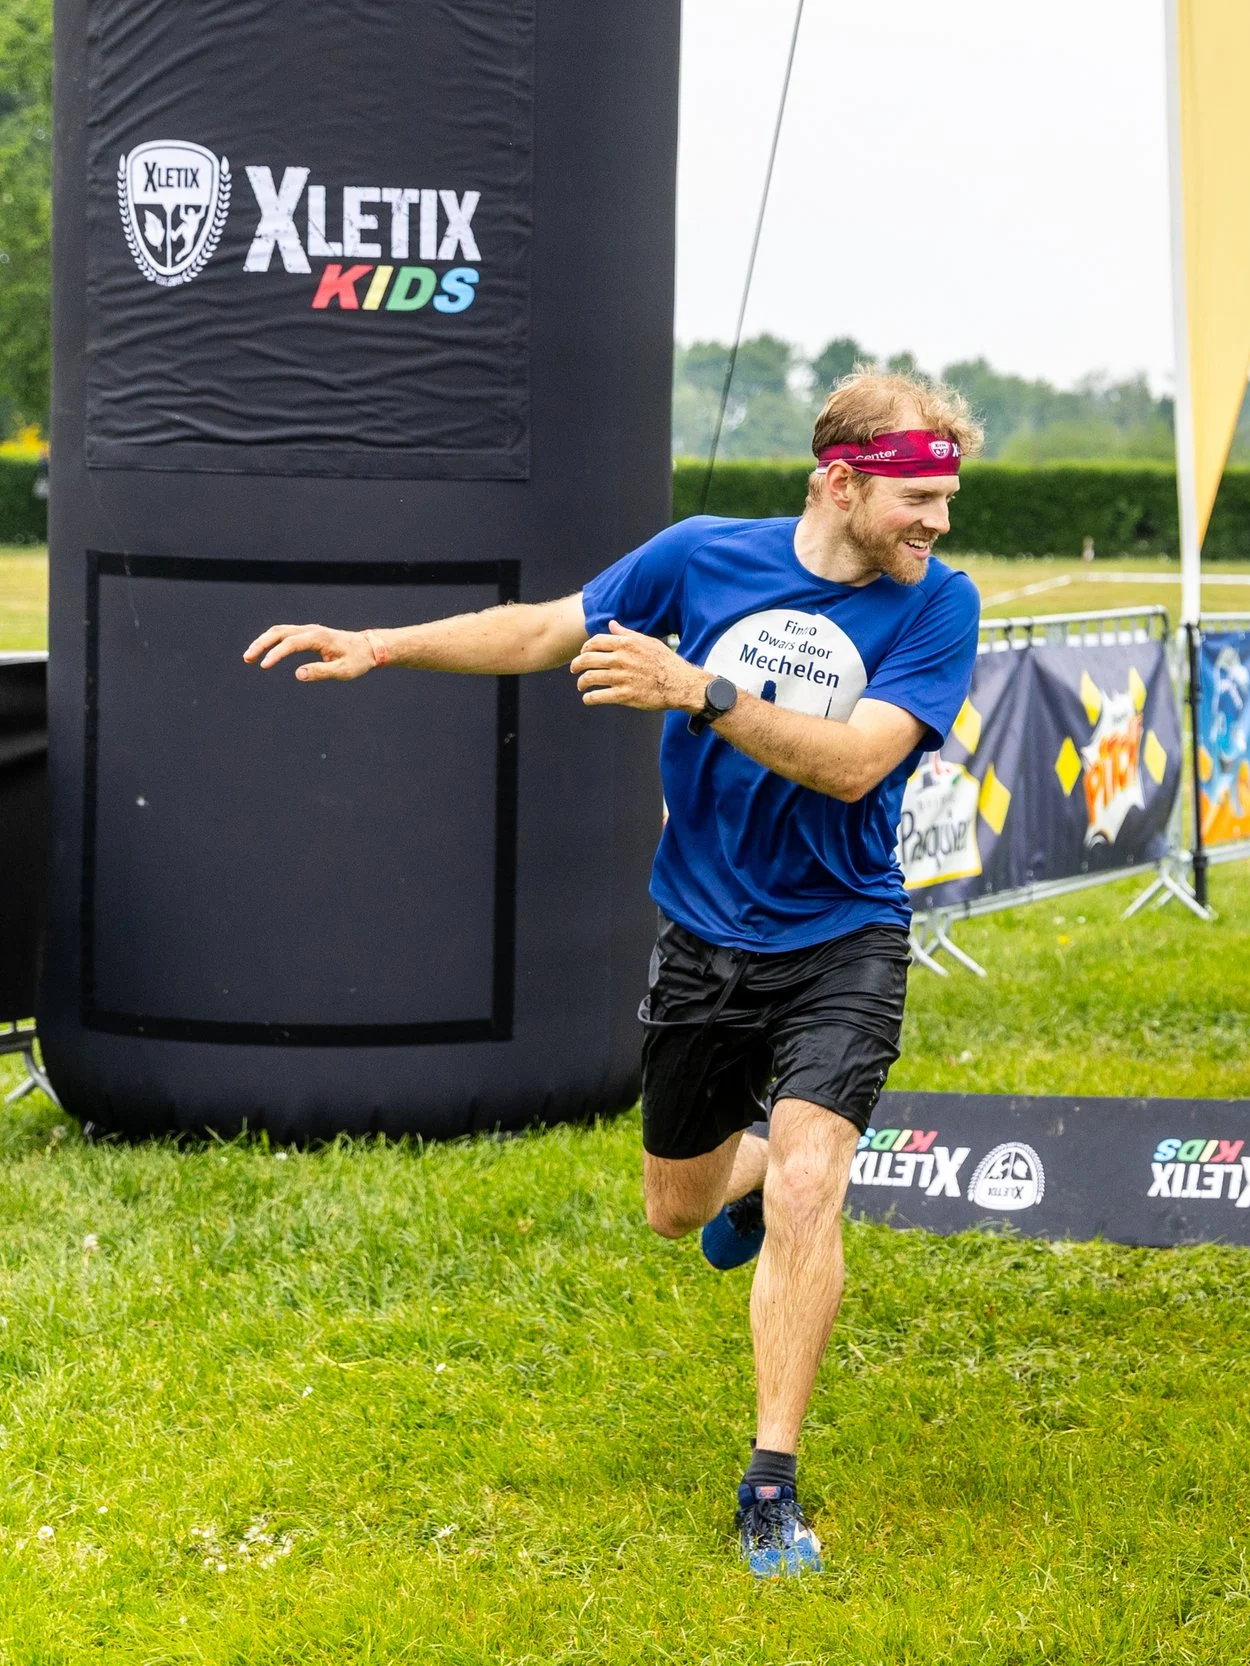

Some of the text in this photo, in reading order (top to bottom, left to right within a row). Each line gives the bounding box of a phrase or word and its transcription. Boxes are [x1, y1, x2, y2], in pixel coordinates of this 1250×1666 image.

[144, 161, 199, 193] XLETIX
[243, 165, 482, 274] XLETIX
[311, 263, 480, 314] KIDS
[758, 629, 833, 660] Dwars door
[738, 643, 841, 689] Mechelen
[857, 1127, 939, 1153] KIDS
[1153, 1137, 1245, 1163] KIDS
[849, 1146, 972, 1198] XLETIX
